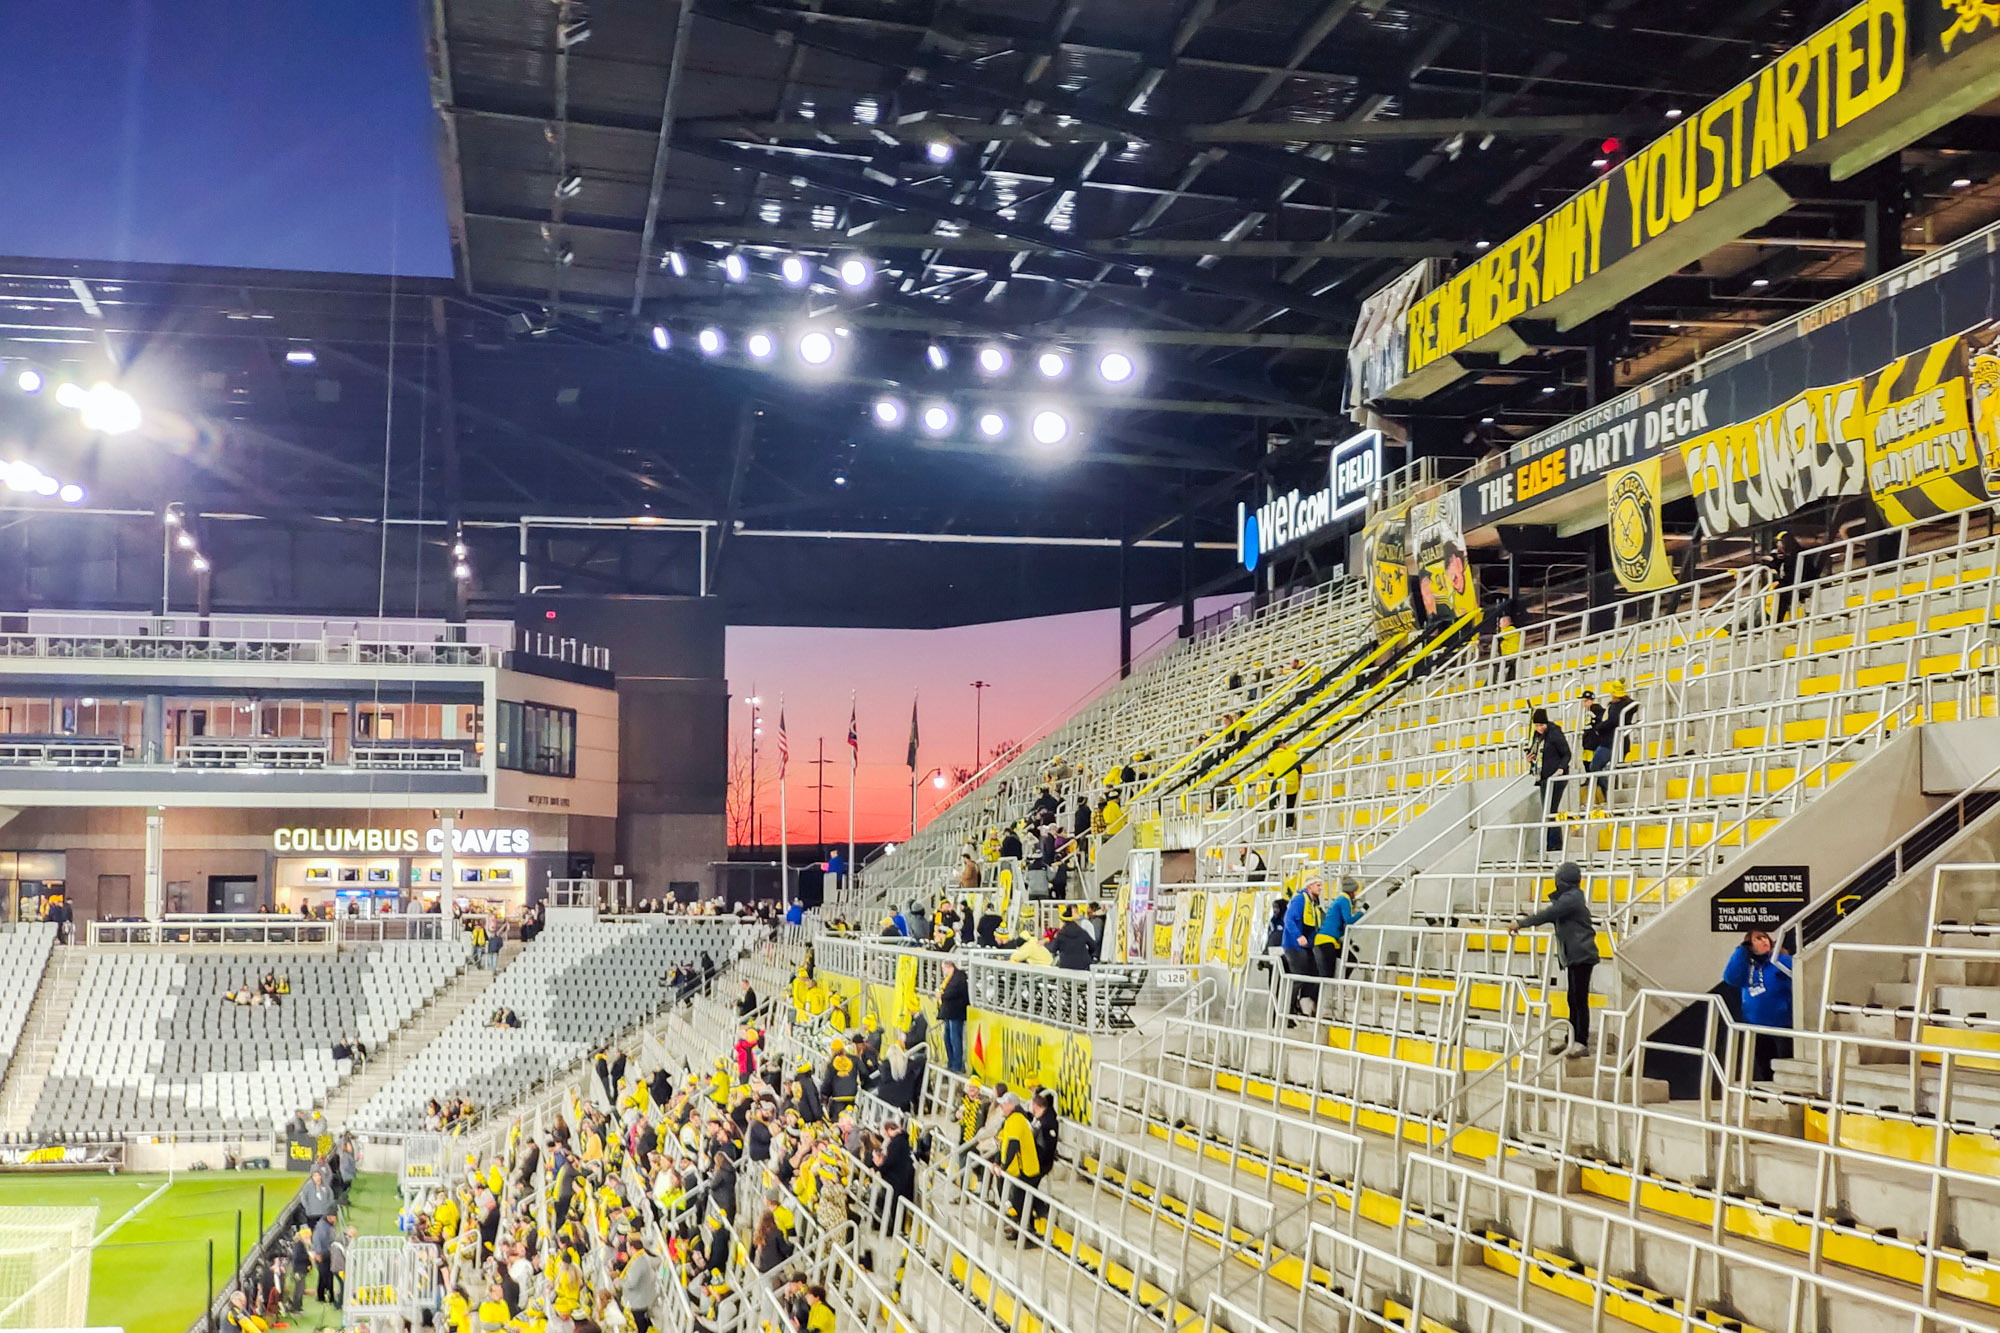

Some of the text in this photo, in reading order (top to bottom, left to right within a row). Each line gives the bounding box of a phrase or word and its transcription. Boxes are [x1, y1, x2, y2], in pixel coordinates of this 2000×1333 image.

[1407, 223, 1543, 374] REMEMBER
[1542, 178, 1610, 303] WHY
[1478, 388, 1709, 516] THE EASE PARTY DECK
[1337, 449, 1374, 498] FIELD
[274, 828, 530, 853] COLUMBUS CRAVES
[1744, 874, 1803, 882] WELCOME TO THE
[1744, 882, 1803, 893] NORDECKE
[1718, 907, 1768, 915] THIS AREA IS
[1718, 914, 1780, 923] STANDING ROOM
[1718, 923, 1739, 931] ONLY
[1167, 974, 1185, 983] 128
